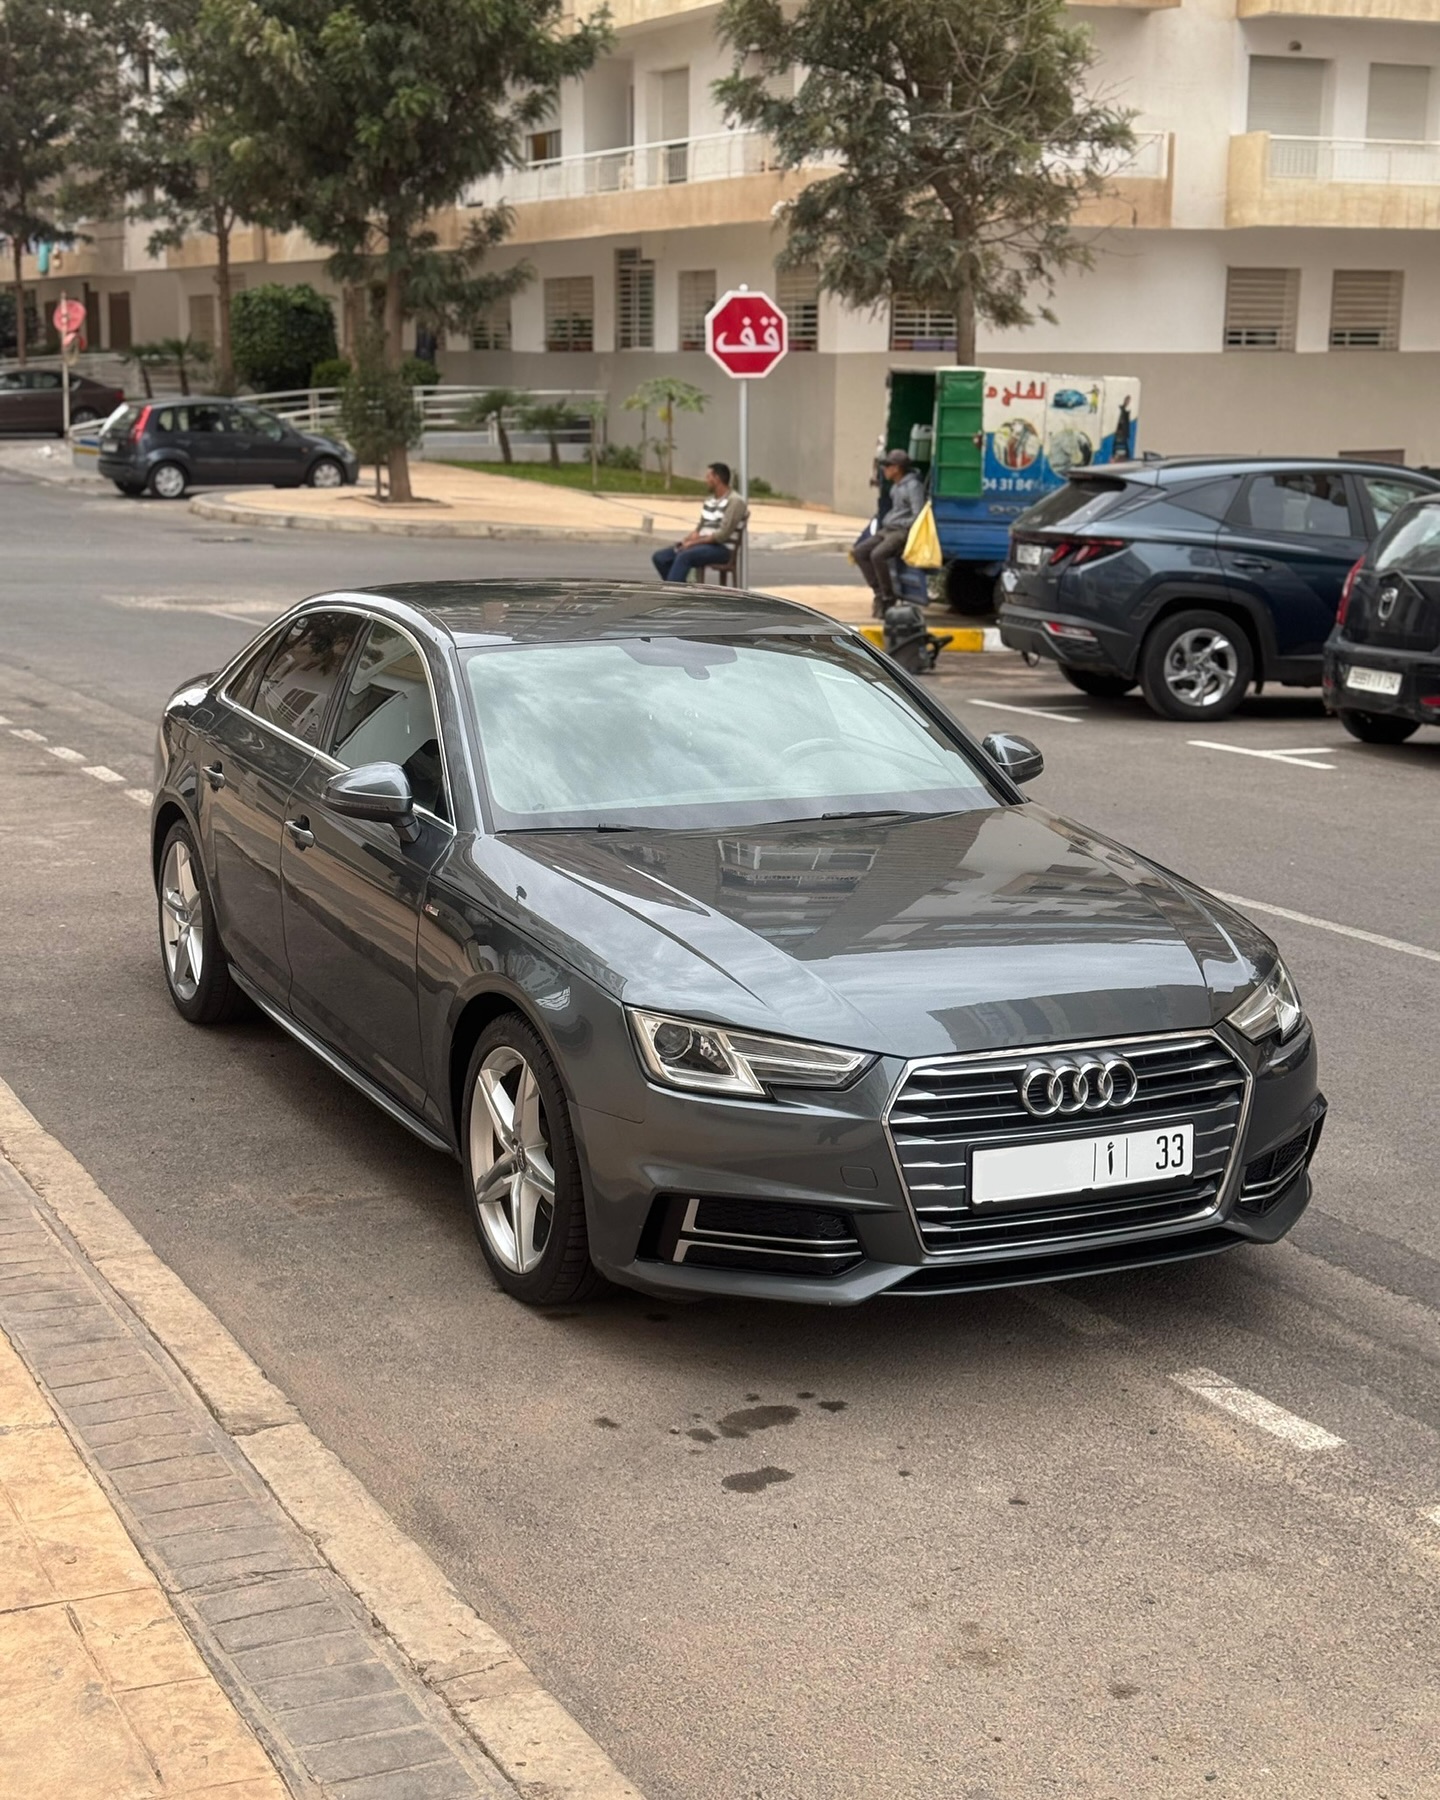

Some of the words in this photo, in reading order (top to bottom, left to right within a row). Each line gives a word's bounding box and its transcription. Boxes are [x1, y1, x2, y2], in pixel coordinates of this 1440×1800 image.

[715, 316, 780, 353] قف
[999, 478, 1014, 491] 31
[1155, 1133, 1184, 1170] 33
